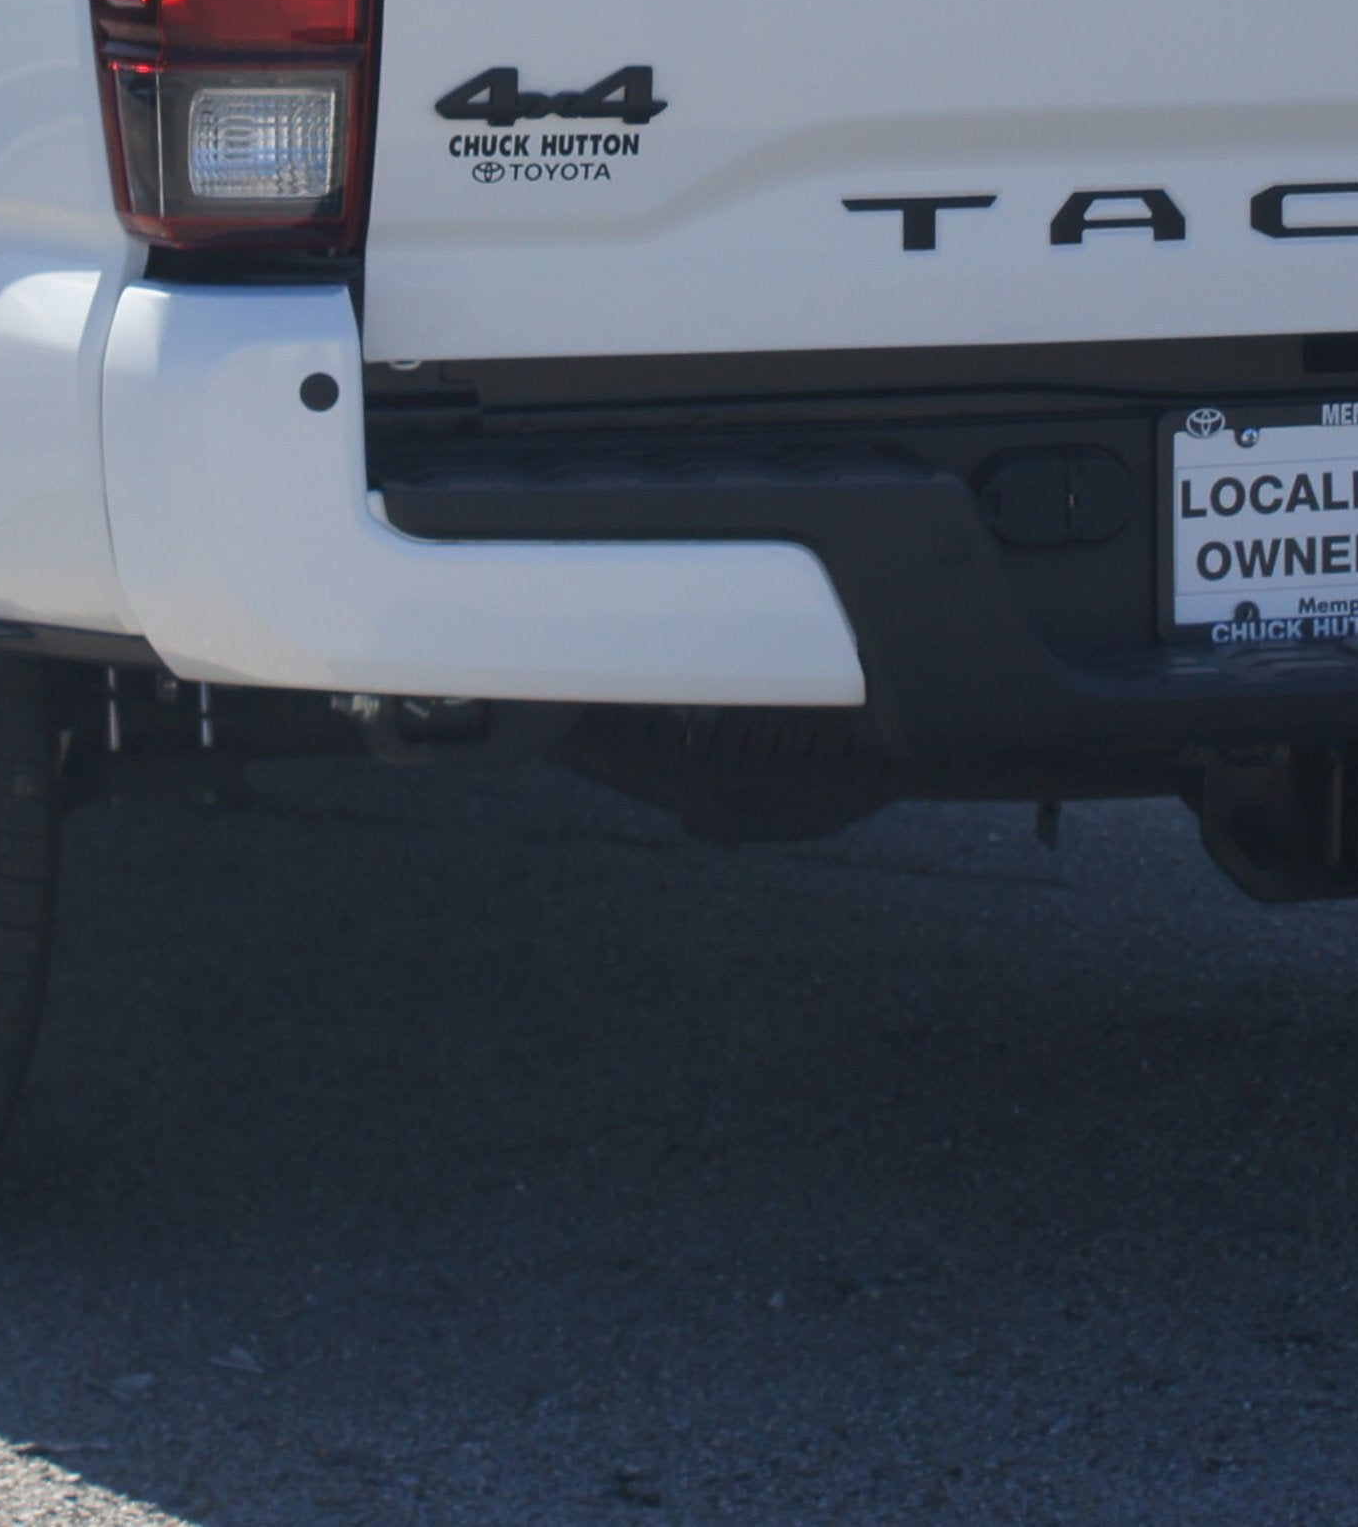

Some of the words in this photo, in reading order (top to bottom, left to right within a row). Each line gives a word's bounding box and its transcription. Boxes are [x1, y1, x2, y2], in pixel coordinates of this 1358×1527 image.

[448, 134, 531, 158] CHUCK
[540, 133, 640, 157] HUTTON
[509, 162, 612, 182] TOYOTA
[1210, 619, 1303, 644] CHUCK
